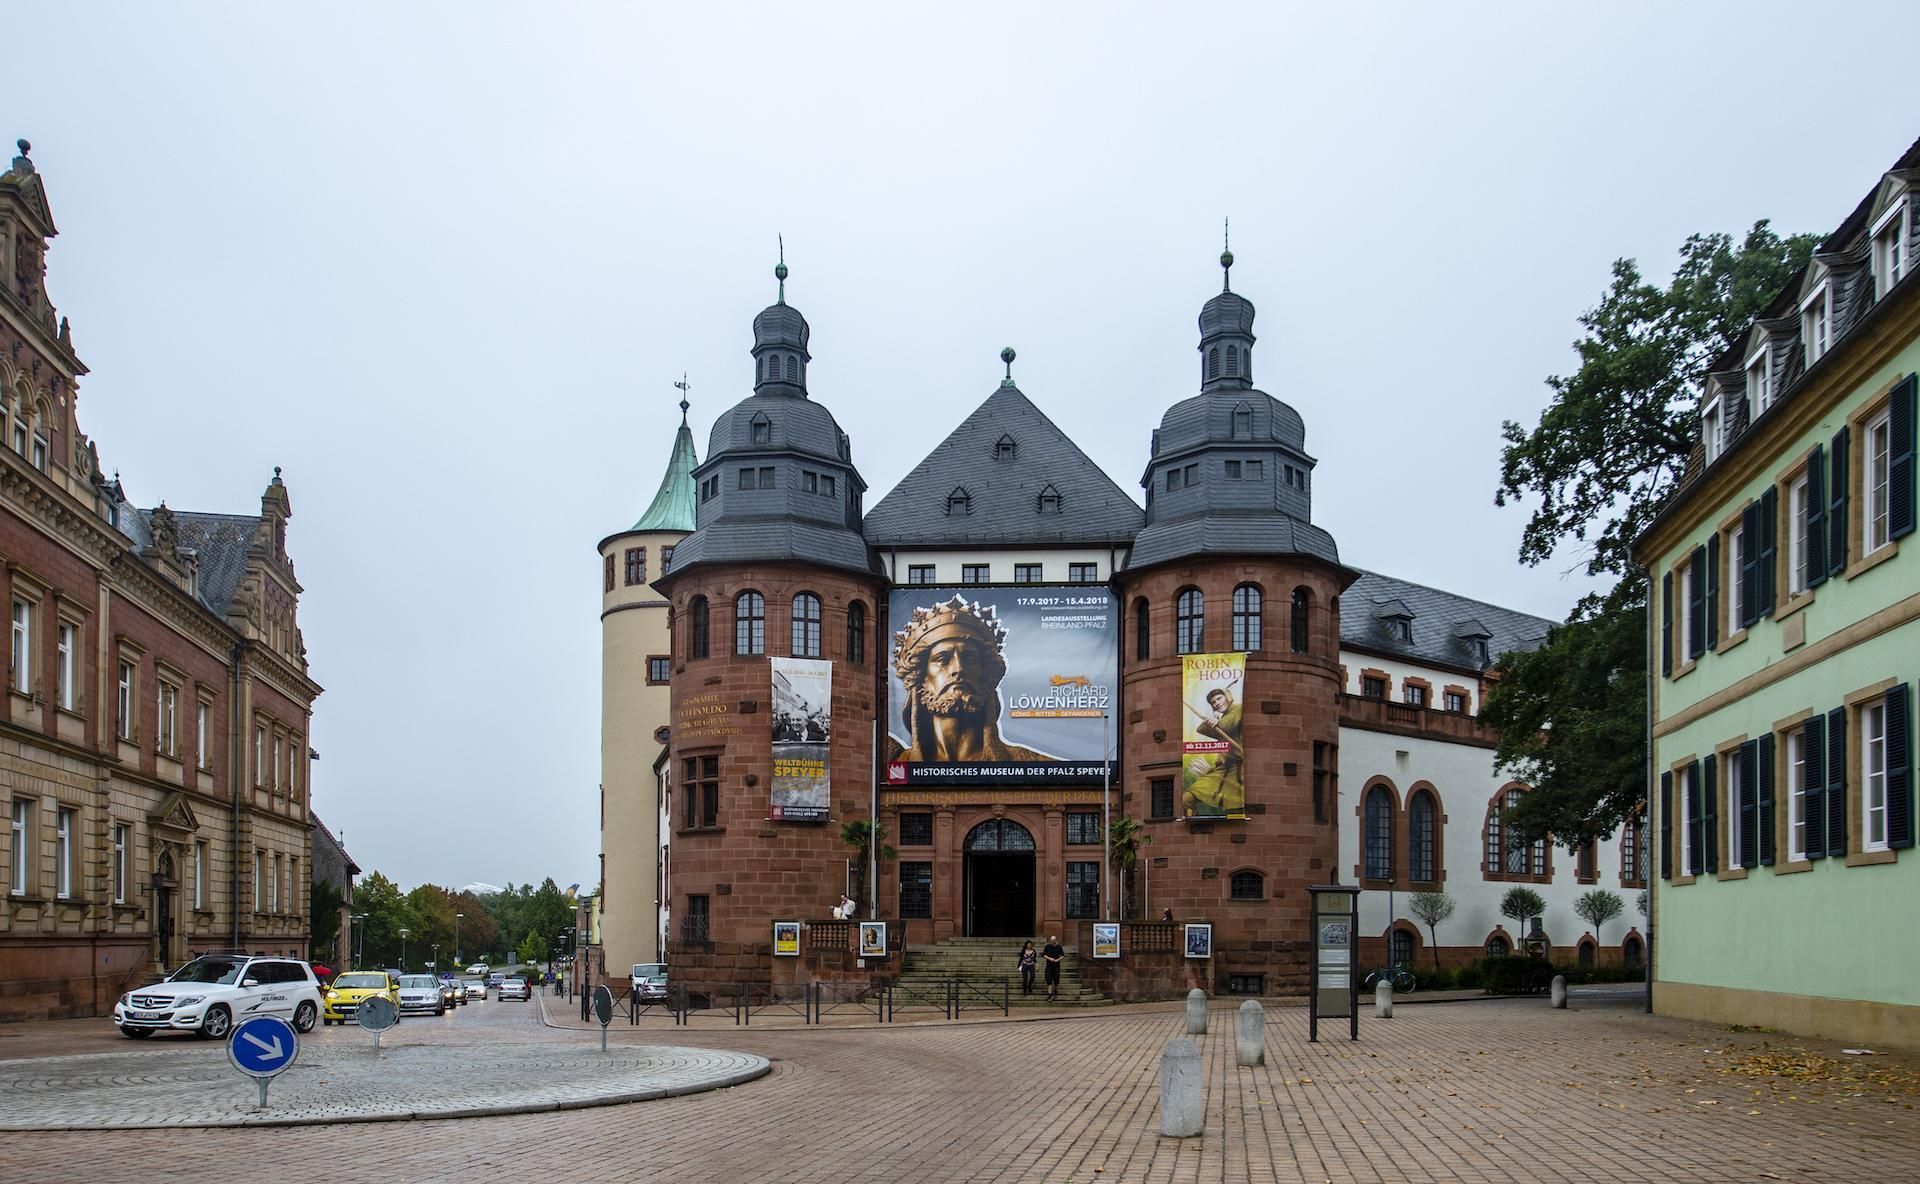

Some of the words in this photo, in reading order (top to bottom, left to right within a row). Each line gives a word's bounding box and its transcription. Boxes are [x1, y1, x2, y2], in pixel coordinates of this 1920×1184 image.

[1187, 658, 1230, 670] ROBIN
[1199, 669, 1243, 680] HOOD
[1051, 686, 1108, 696] RICHARD
[1010, 694, 1109, 709] LÖWENHERZ
[774, 758, 824, 767] WELTBÜHNE
[774, 766, 825, 778] SPEYER
[913, 768, 978, 776] HISTORISCHES
[980, 768, 1024, 776] MUSEUM
